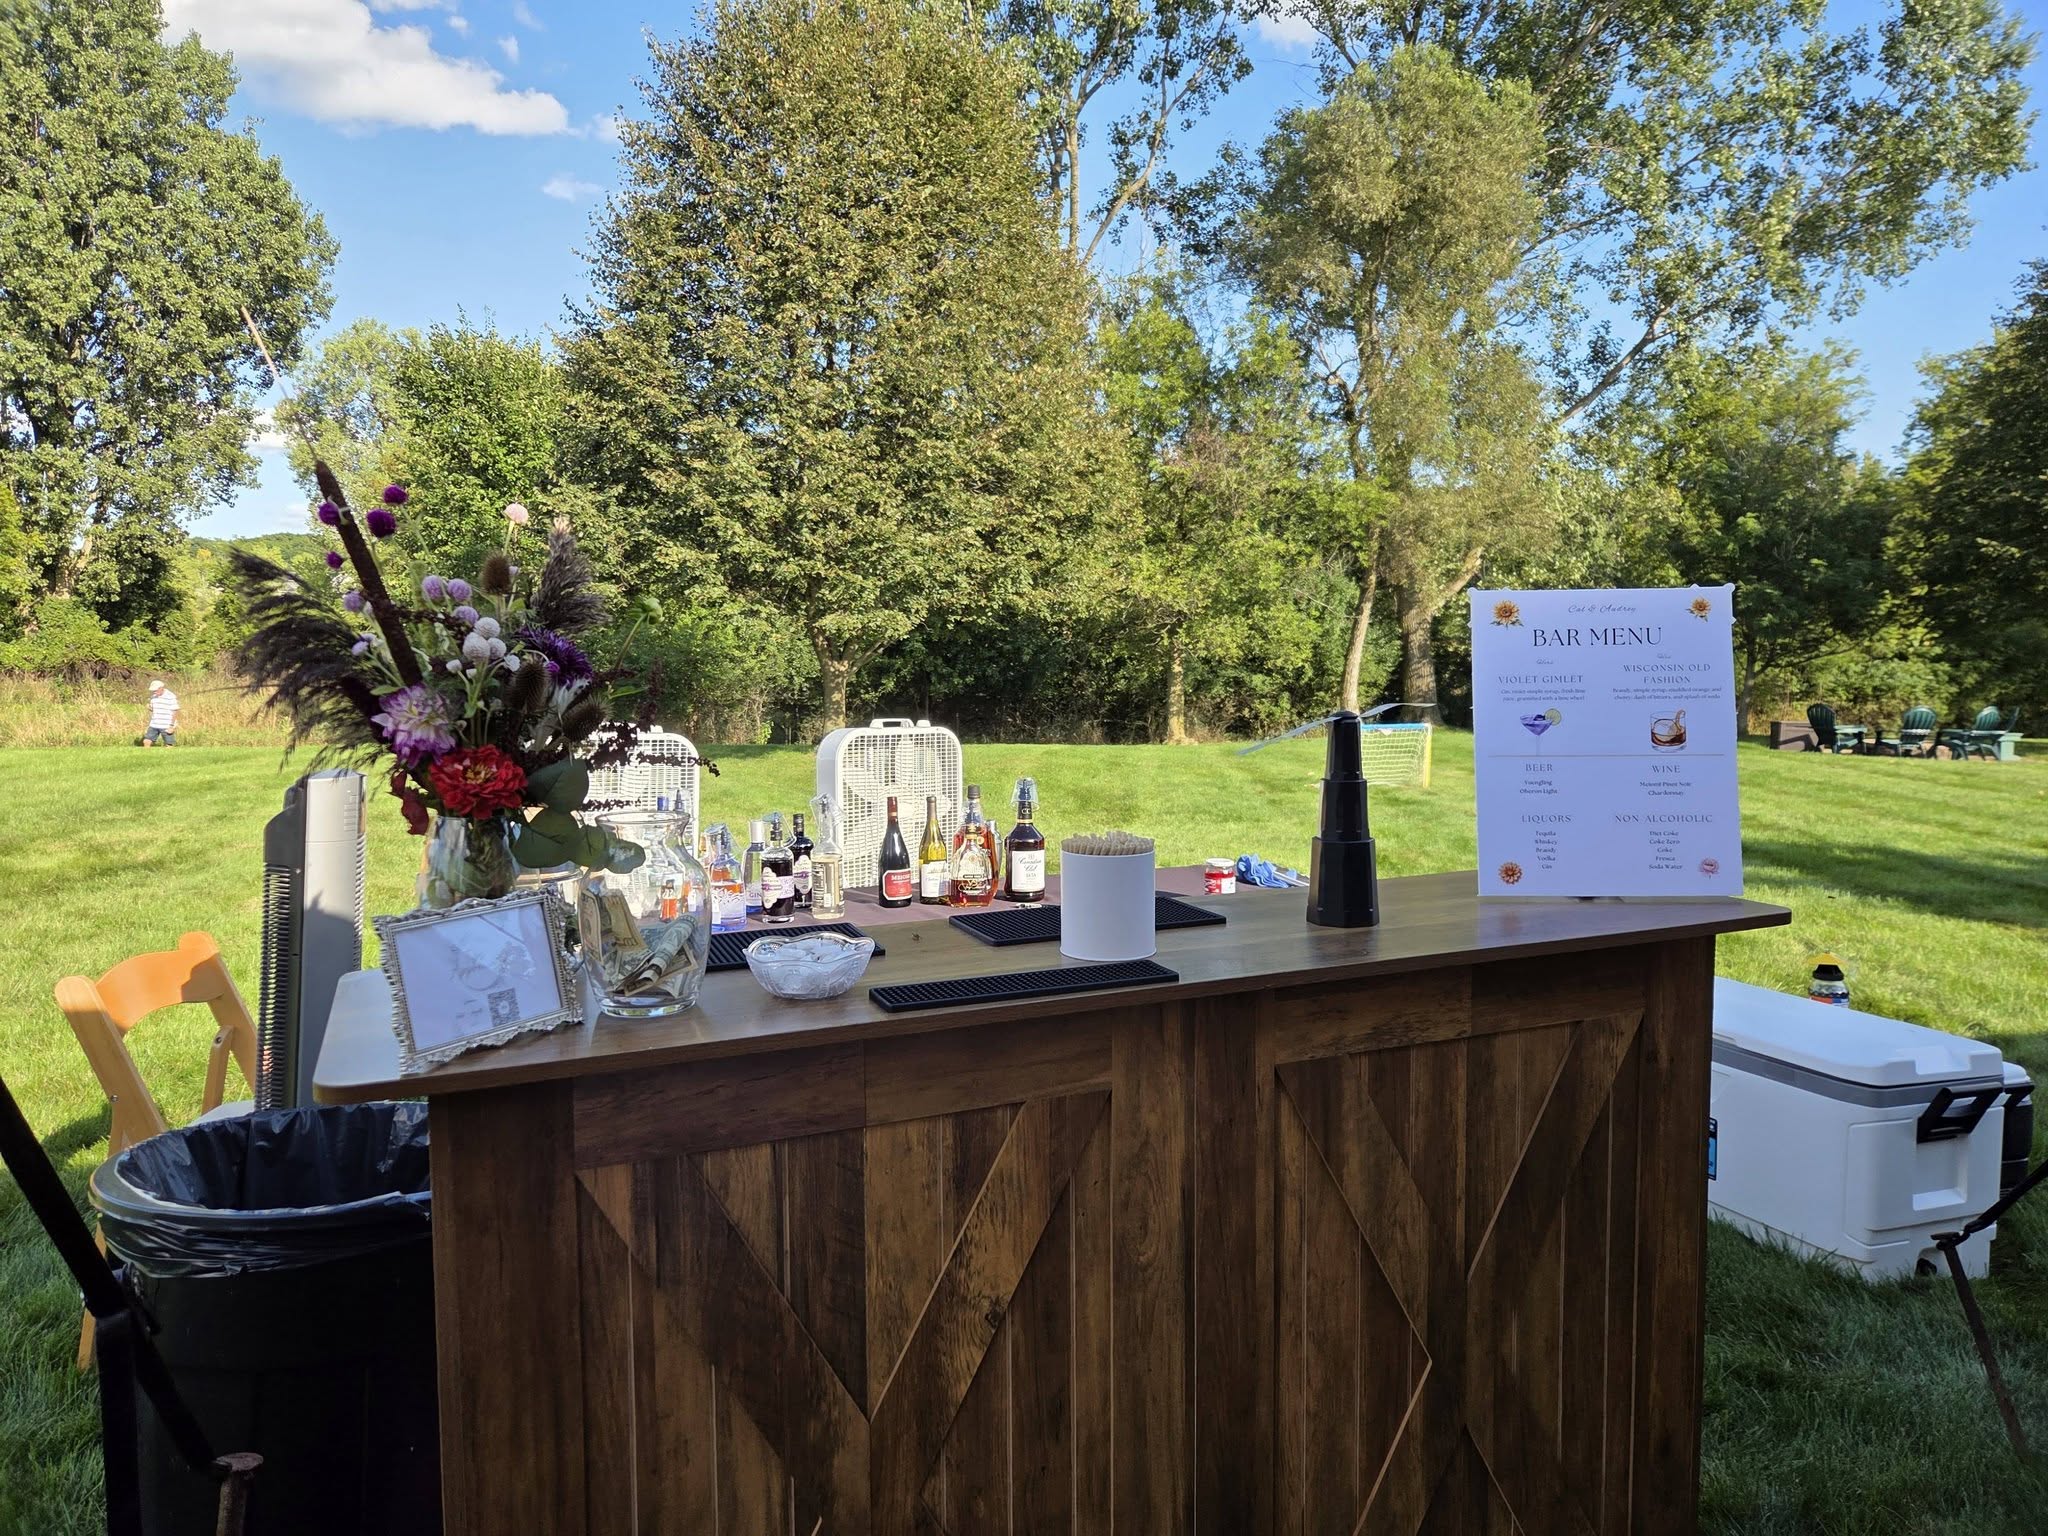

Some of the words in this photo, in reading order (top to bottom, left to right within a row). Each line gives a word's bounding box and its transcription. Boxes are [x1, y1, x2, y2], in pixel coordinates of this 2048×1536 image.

[1533, 628, 1581, 647] BAR
[1589, 627, 1662, 646] MENU
[1623, 664, 1685, 672] WISCONSIN
[1688, 663, 1711, 672] OLD
[1498, 675, 1537, 684] VIOLET
[1542, 675, 1584, 684] GIMLET
[1643, 675, 1691, 684] FASHION
[1525, 763, 1553, 772] BEER
[1652, 765, 1681, 773] WINE
[1521, 814, 1572, 824] LIQUORS
[1615, 814, 1639, 823] NON
[1645, 814, 1713, 823] ALCOHOLIC
